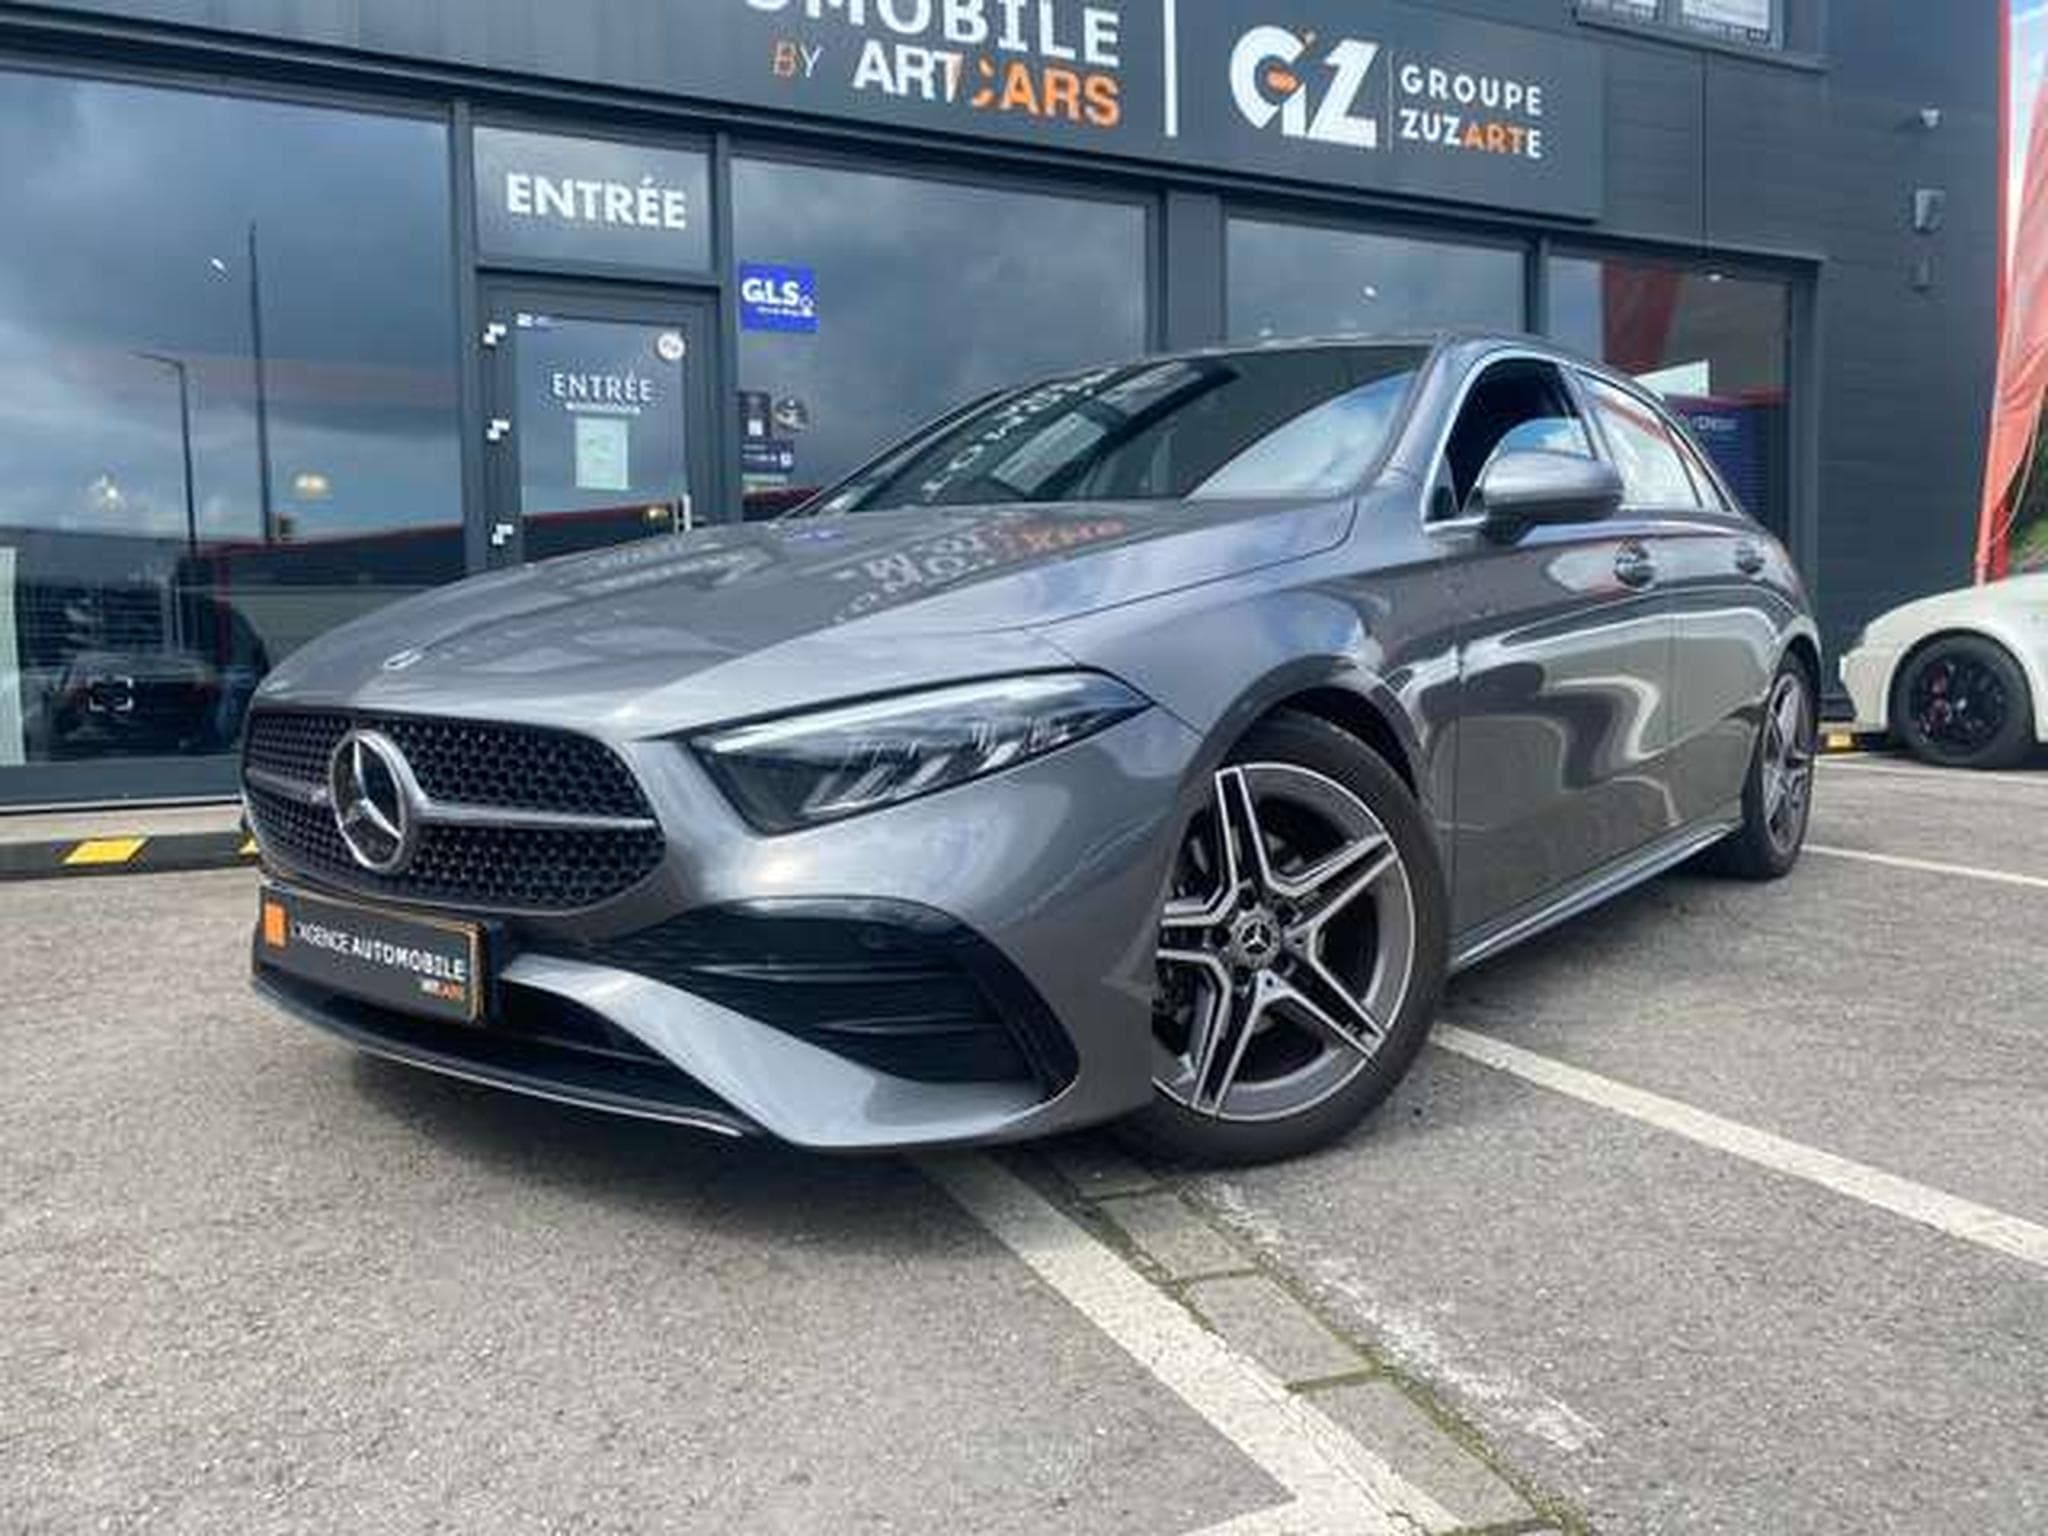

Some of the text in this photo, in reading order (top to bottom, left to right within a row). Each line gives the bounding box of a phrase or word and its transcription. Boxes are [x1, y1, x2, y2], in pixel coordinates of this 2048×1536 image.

[746, 0, 1121, 66] OBILE
[773, 41, 824, 79] BY
[1399, 65, 1543, 116] GROUPE
[1399, 108, 1543, 159] ZUZARTE
[506, 172, 687, 229] ENTRÉE
[552, 370, 653, 401] ENTRÉE
[352, 937, 467, 982] AUTOMOBILE
